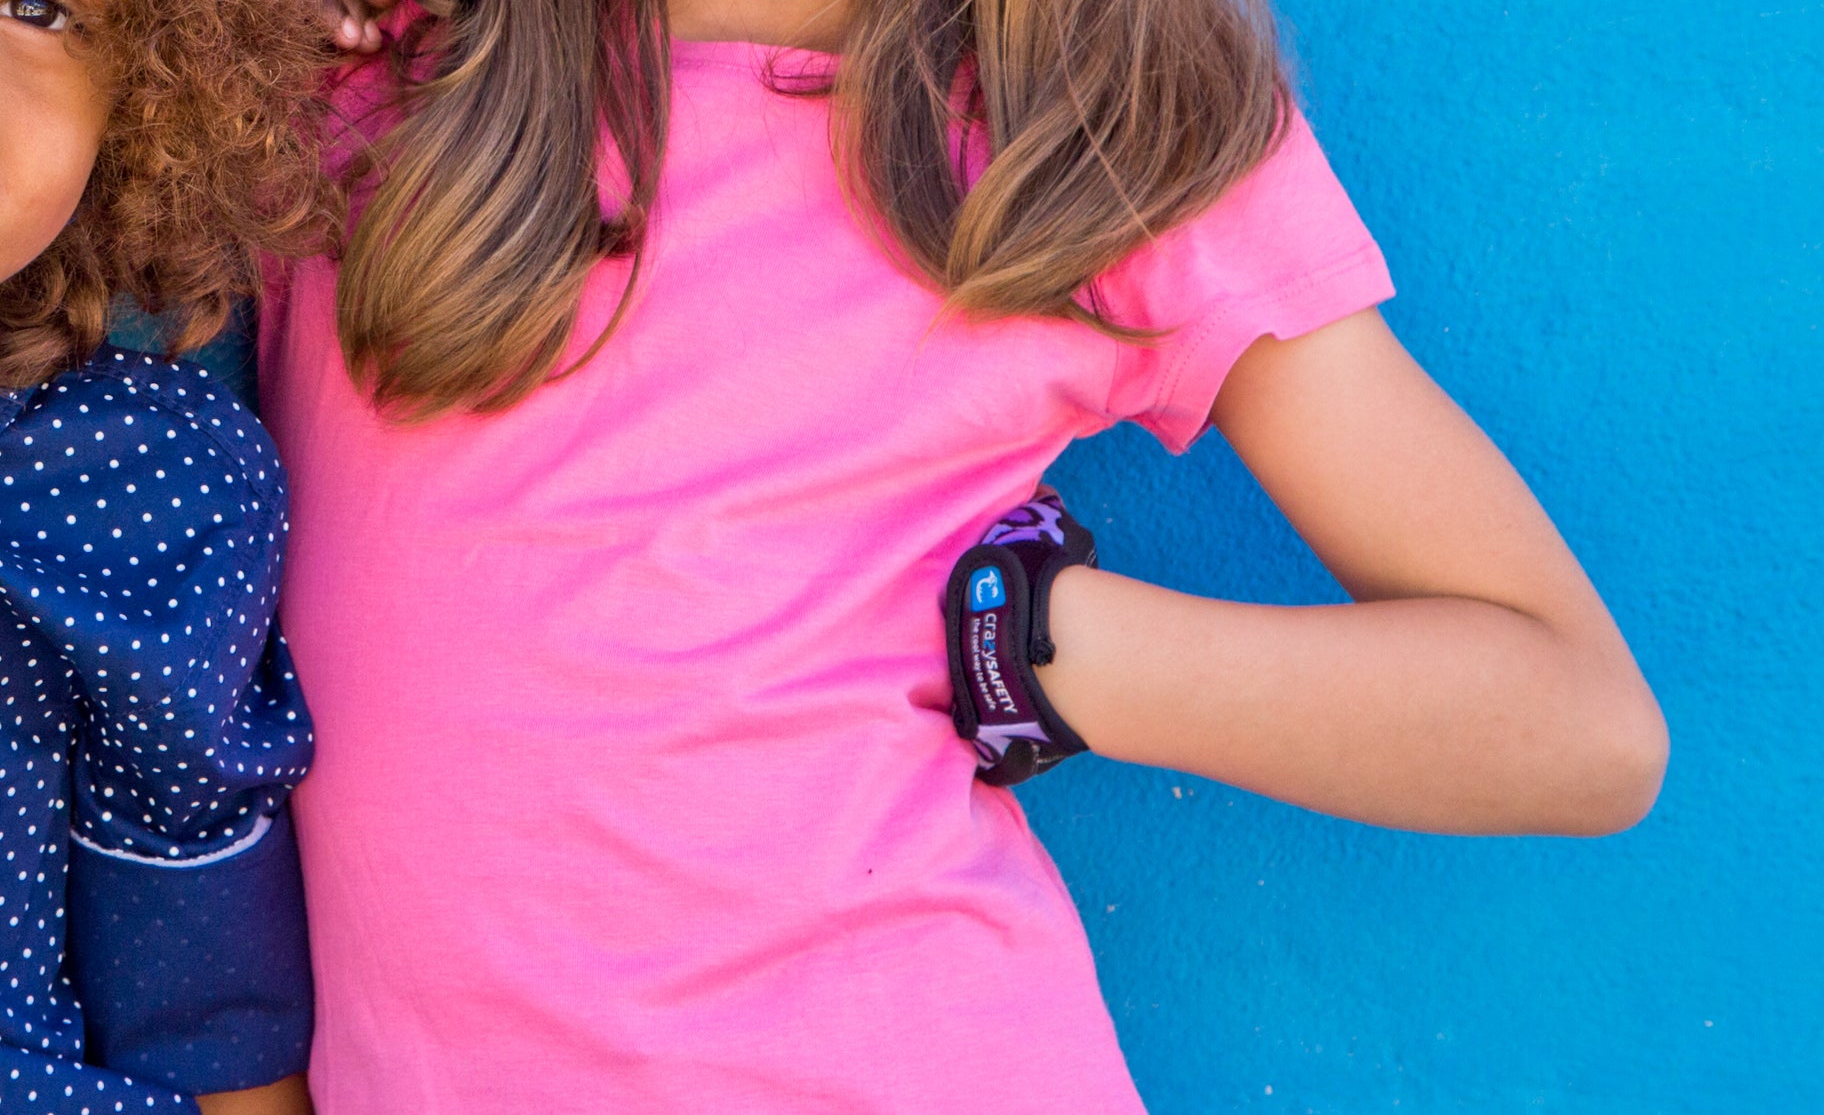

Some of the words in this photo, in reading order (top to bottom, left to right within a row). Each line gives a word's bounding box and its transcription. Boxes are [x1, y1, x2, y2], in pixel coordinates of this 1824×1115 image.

[973, 618, 981, 633] the
[972, 635, 980, 653] cool
[973, 654, 981, 672] way
[981, 613, 1018, 713] crazySAFETY
[976, 672, 984, 682] to
[979, 682, 989, 694] be
